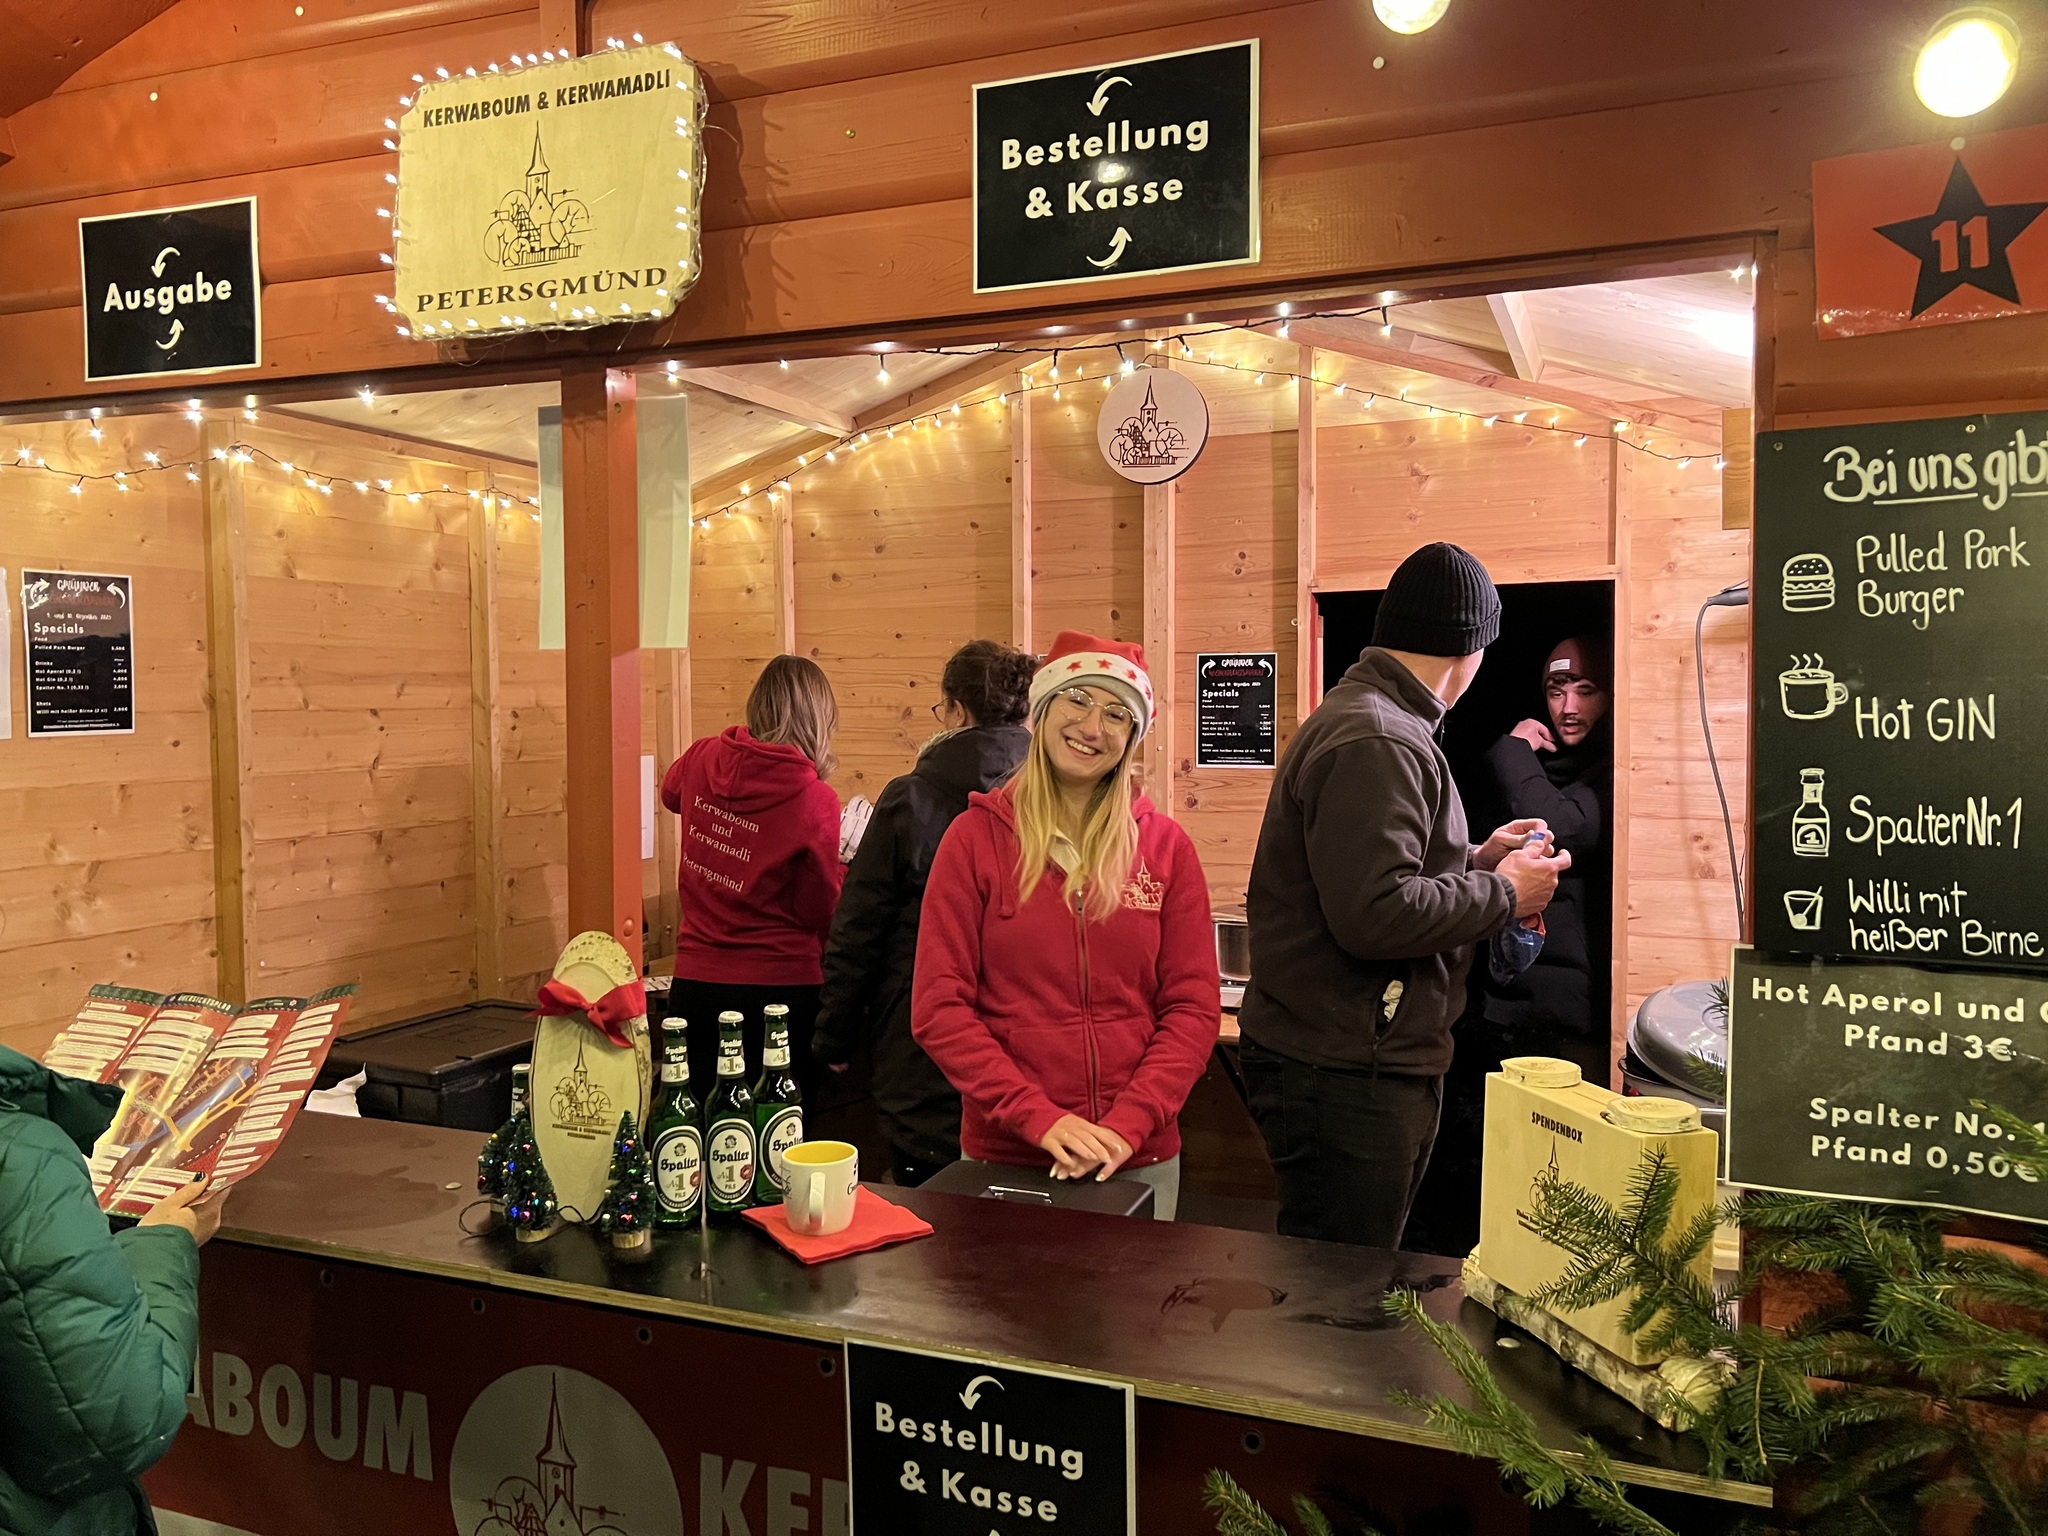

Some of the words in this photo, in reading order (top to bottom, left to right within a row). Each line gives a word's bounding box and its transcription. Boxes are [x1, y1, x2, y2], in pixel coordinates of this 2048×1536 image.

[423, 94, 531, 128] KERWABOUM
[537, 91, 550, 110] &
[556, 69, 671, 107] KERWAMADLI
[1002, 120, 1209, 170] Bestellung
[1025, 186, 1053, 219] &
[1067, 178, 1184, 214] Kasse
[1931, 215, 1990, 273] 11
[103, 271, 232, 315] Ausgabe
[417, 267, 668, 313] PETERSGMÜND
[1823, 445, 1897, 503] Bei
[1908, 453, 1978, 493] uns
[1856, 530, 1948, 574] Pulled
[1963, 526, 2031, 570] Pork
[1857, 579, 1965, 631] Burger
[34, 622, 84, 635] Specials
[1202, 689, 1239, 698] Specials
[1855, 696, 1914, 739] Hot
[1926, 693, 1995, 742] GIN
[694, 795, 760, 833] Kerwaboum
[711, 821, 734, 838] und
[689, 824, 751, 863] Kerwamadli
[1848, 878, 1911, 914] Willi
[1919, 881, 1968, 918] mit
[1849, 918, 1948, 952] heißer
[1961, 919, 2045, 957] Birne
[1752, 977, 1809, 1004] Hot
[1821, 983, 1942, 1016] Aperol
[1957, 998, 2024, 1023] und
[1844, 1024, 1948, 1056] Pfand
[1963, 1034, 2013, 1062] 3€
[1531, 1111, 1583, 1144] SPENDENBOX
[1808, 1097, 1940, 1130] Spalter
[1954, 1111, 2016, 1142] No.
[660, 1157, 698, 1172] Spalter
[712, 1149, 750, 1164] Spalter
[1811, 1134, 1911, 1166] Pfand
[875, 1401, 1084, 1481] Bestellung
[900, 1460, 928, 1494] &
[942, 1468, 1058, 1522] Kasse
